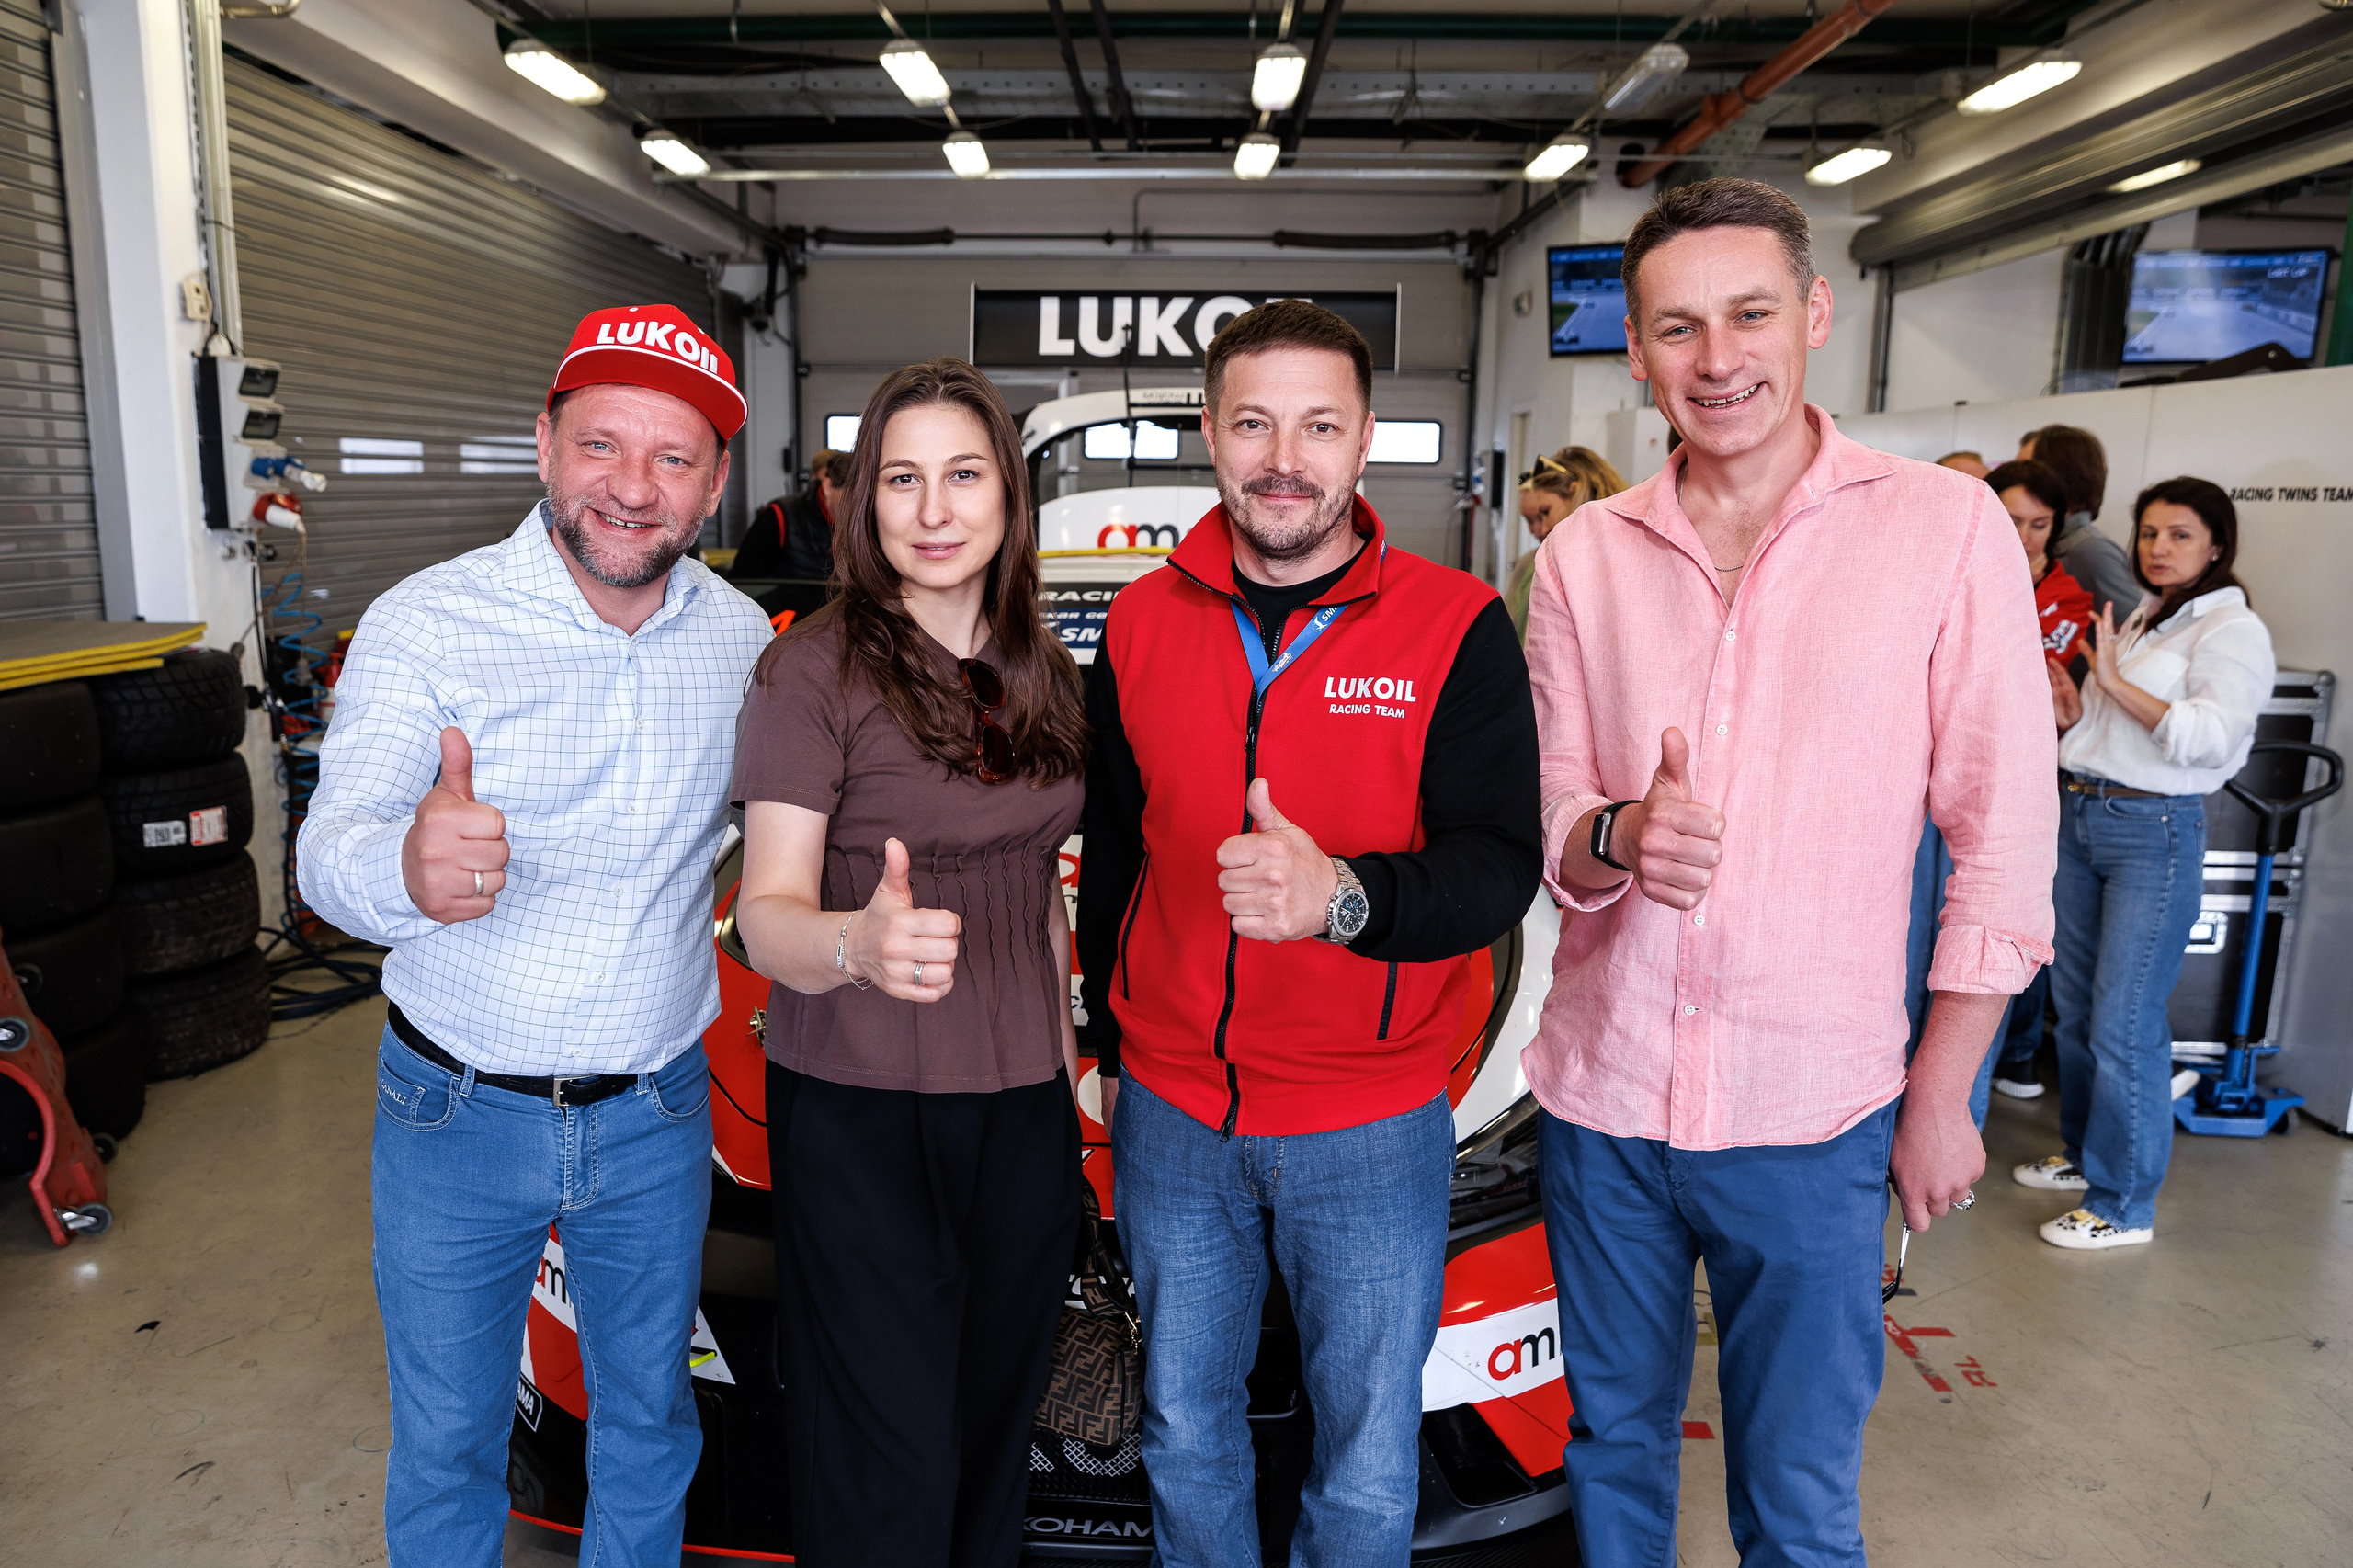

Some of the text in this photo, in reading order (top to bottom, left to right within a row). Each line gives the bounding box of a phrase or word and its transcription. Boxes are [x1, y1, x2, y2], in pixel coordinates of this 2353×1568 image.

[1039, 295, 1313, 357] LUKO
[2278, 487, 2318, 502] TWINS
[1038, 590, 1119, 602] RACI
[1060, 627, 1103, 642] SM
[1324, 676, 1416, 702] LUKOIL
[1329, 704, 1405, 719] RACING TEAM
[1488, 1327, 1561, 1381] am
